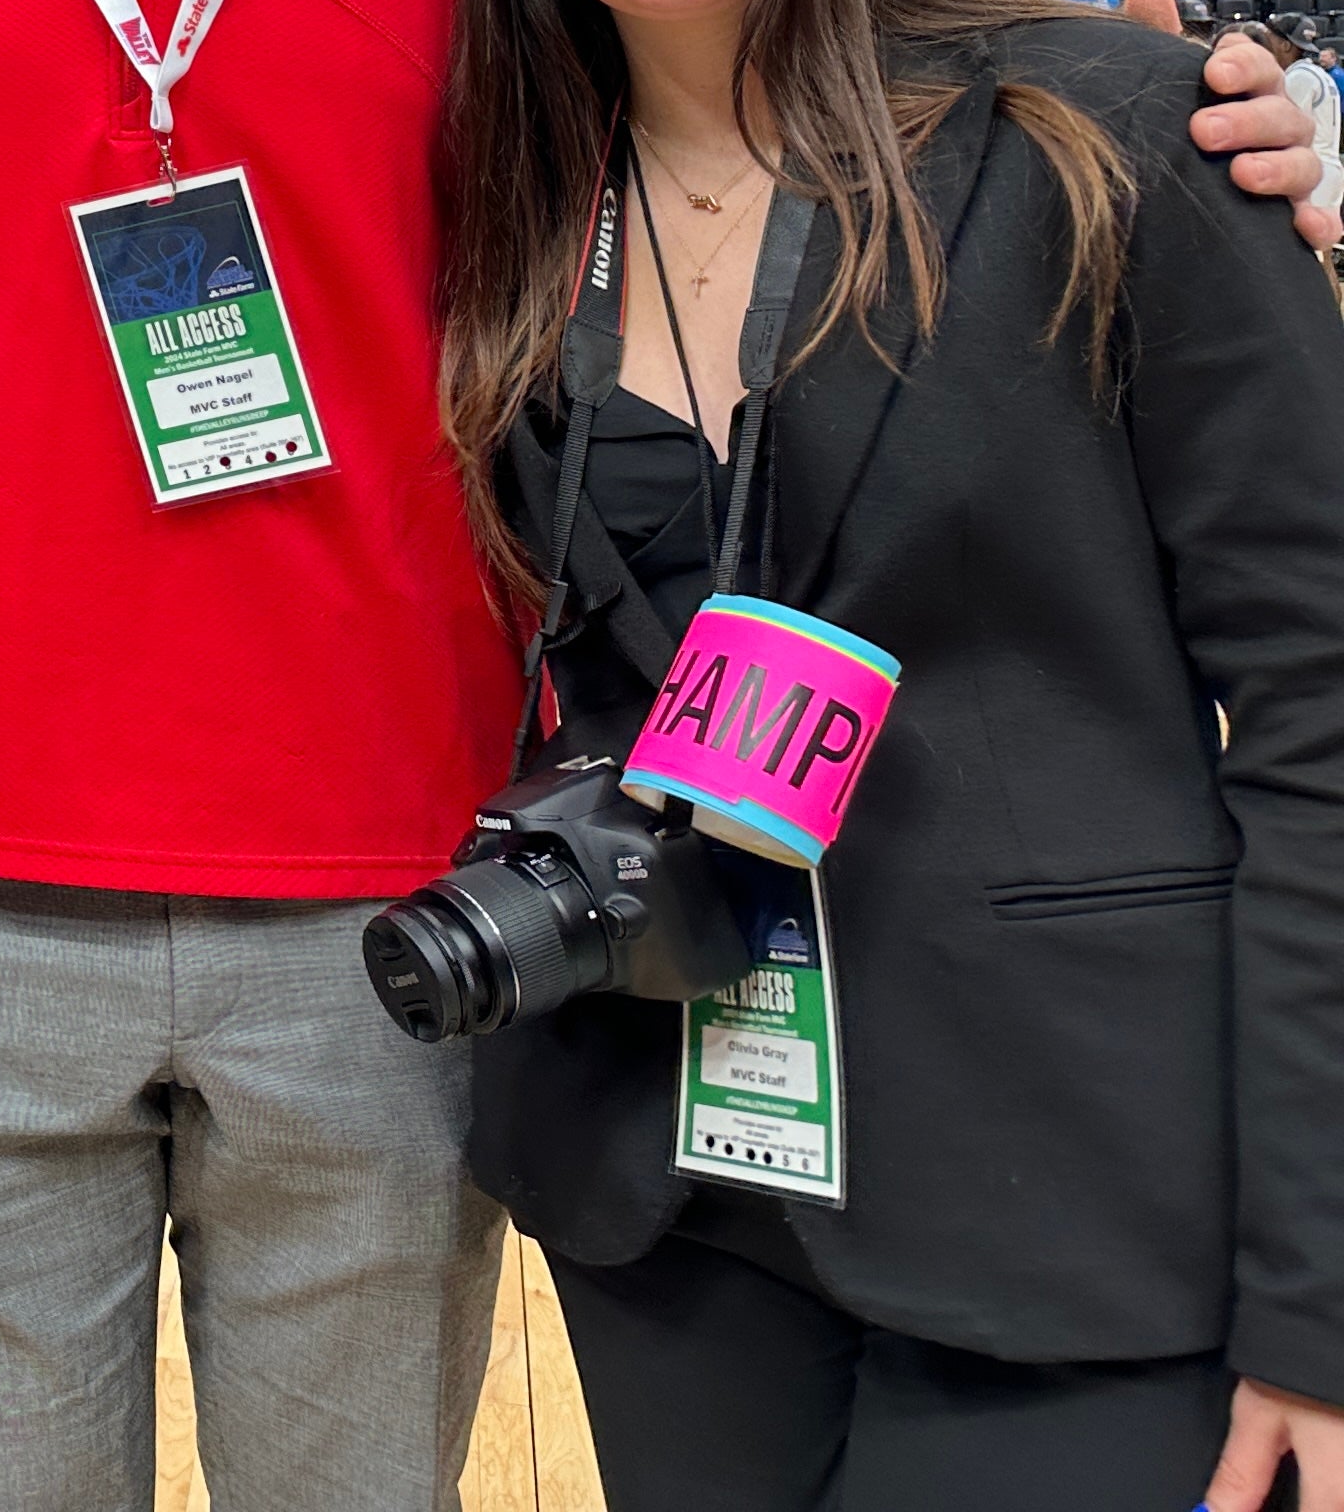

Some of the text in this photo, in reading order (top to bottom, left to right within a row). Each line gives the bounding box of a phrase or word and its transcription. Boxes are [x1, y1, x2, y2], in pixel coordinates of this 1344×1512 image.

[591, 187, 617, 291] Canon
[145, 303, 247, 356] ALL ACCESS
[176, 369, 254, 395] Owen Nagel
[190, 392, 254, 415] MVC Staff
[183, 454, 253, 480] 1 2 4
[475, 813, 512, 832] Canon
[616, 856, 643, 871] EOS
[617, 867, 649, 881] 4000D
[386, 971, 420, 990] Canon
[762, 1045, 789, 1063] Gray
[730, 1067, 787, 1088] MVC Staff
